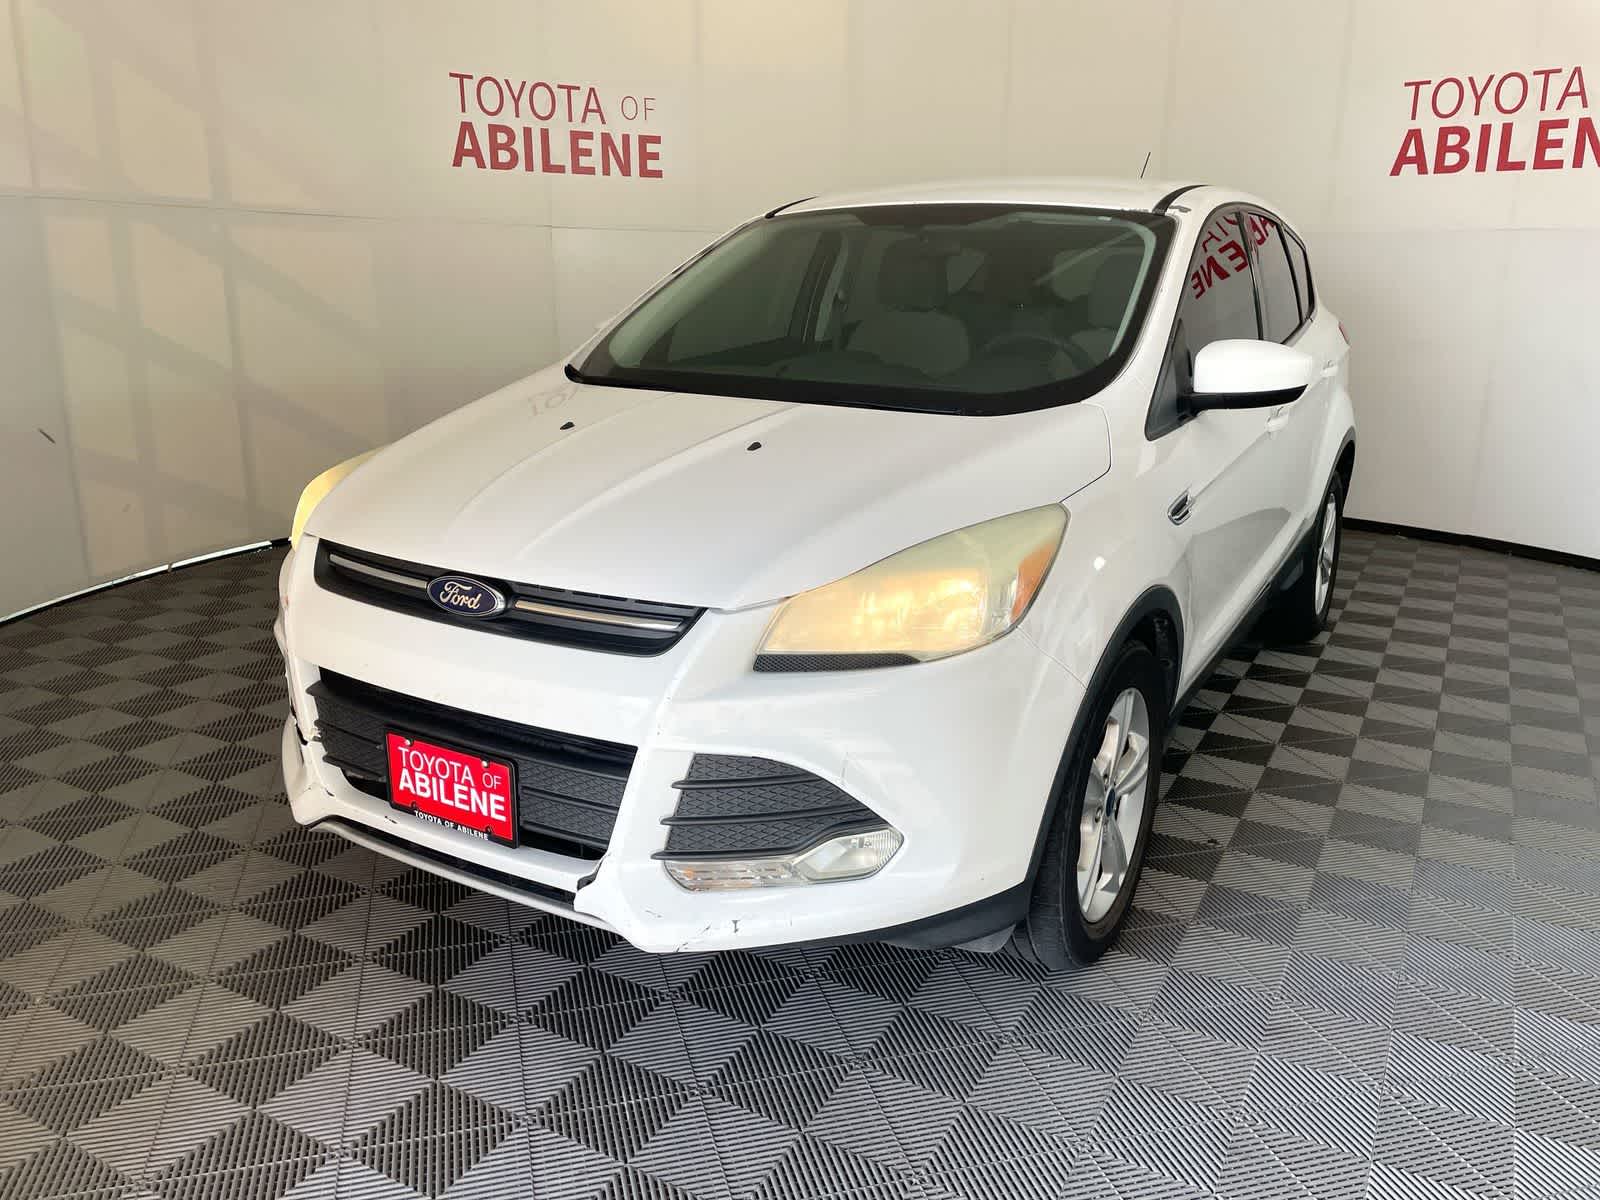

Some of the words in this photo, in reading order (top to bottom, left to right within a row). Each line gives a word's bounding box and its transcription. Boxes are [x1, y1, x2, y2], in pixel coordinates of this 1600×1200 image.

[448, 72, 606, 124] TOYOTA
[620, 95, 656, 121] OF
[1404, 66, 1588, 120] TOYOTA
[451, 121, 663, 178] ABILENE
[440, 581, 481, 609] Ford
[398, 746, 475, 787] TOYOTA
[482, 773, 502, 789] OF
[399, 768, 507, 822] ABILENE
[414, 810, 442, 825] TOYOTA
[444, 820, 454, 829] OF
[457, 824, 489, 841] ABILENE
